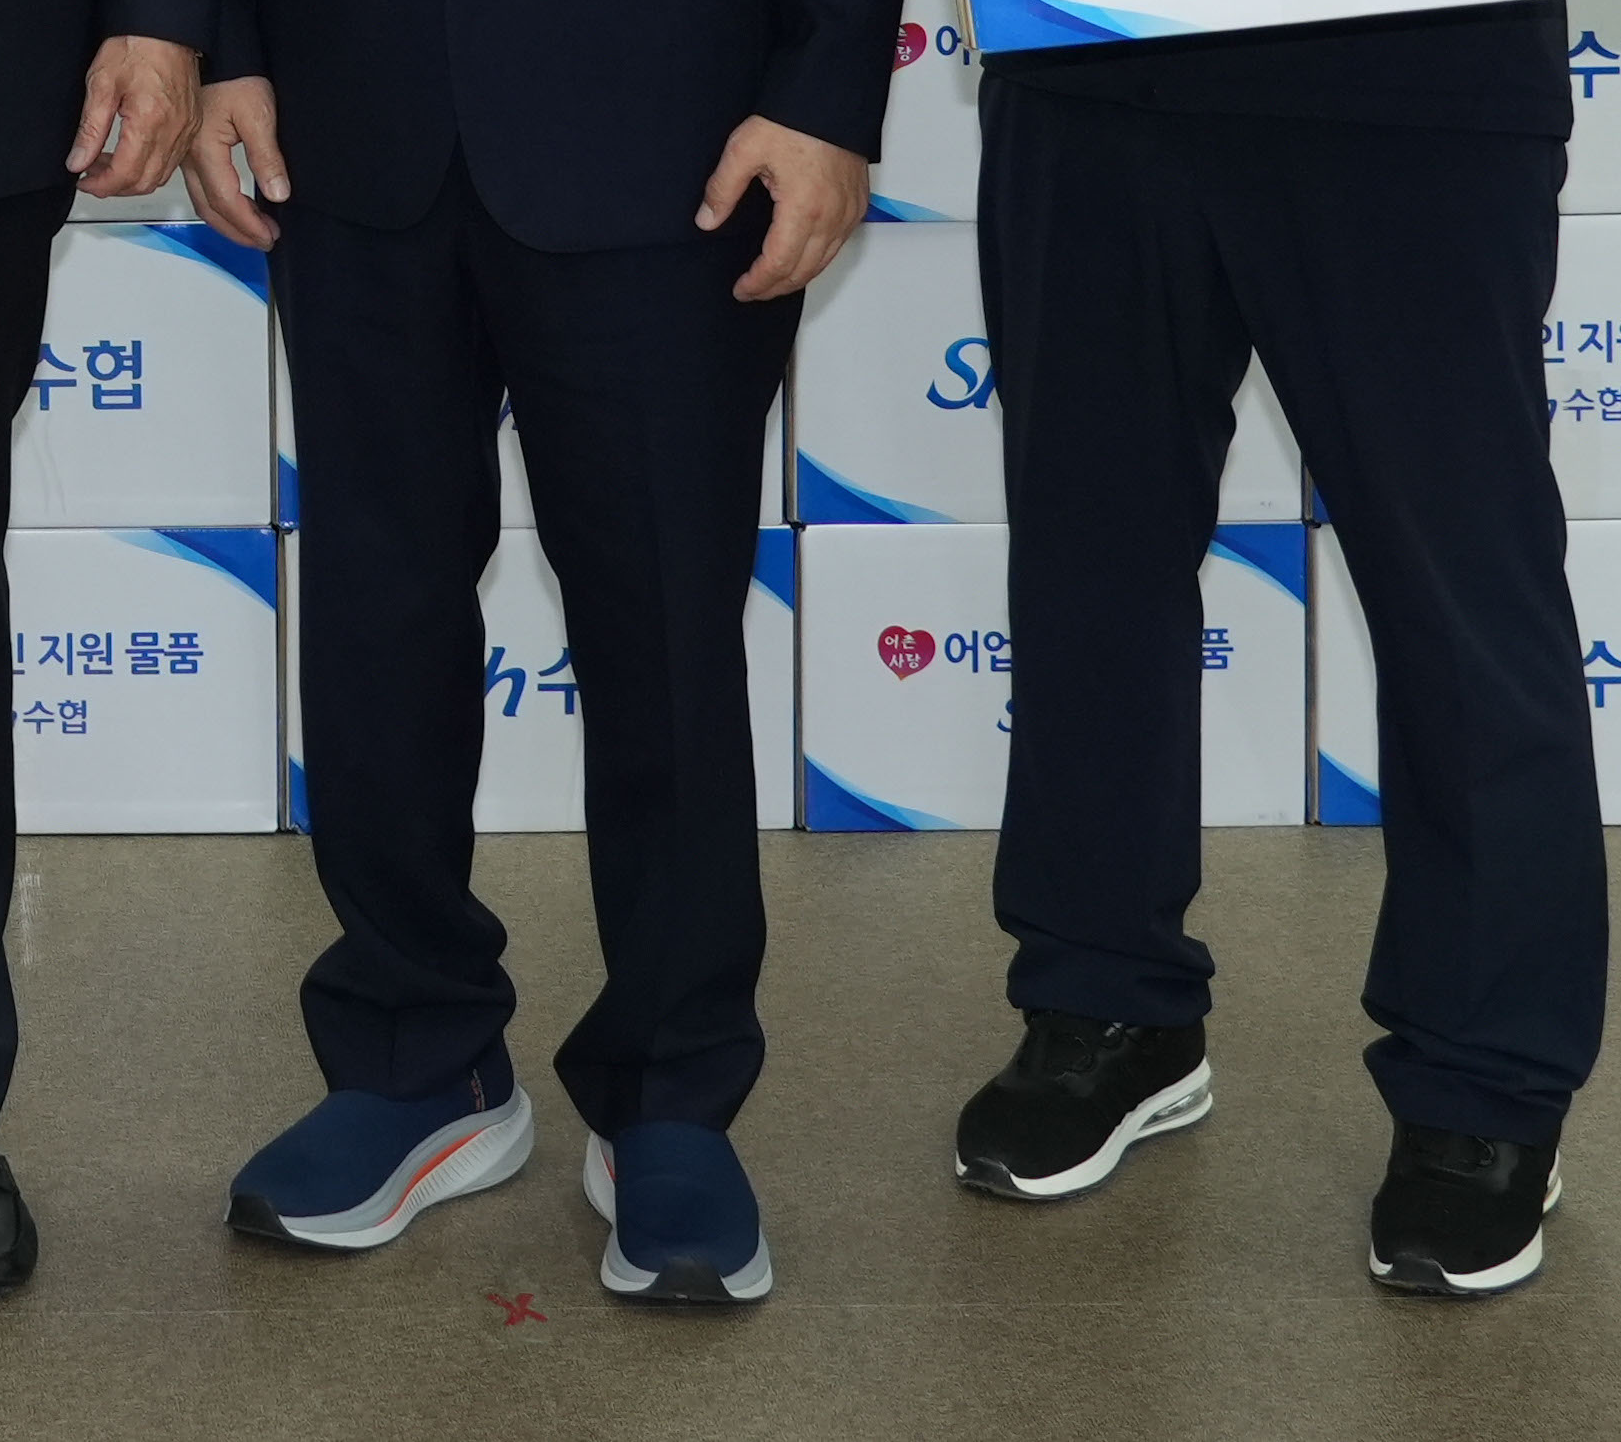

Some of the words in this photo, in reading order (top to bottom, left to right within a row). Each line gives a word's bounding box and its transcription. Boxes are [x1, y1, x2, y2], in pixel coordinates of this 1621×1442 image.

[30, 340, 144, 412] 수협
[38, 632, 115, 675] 지원
[124, 629, 204, 675] 물품
[944, 631, 1012, 673] 어업
[14, 700, 89, 735] 수협
